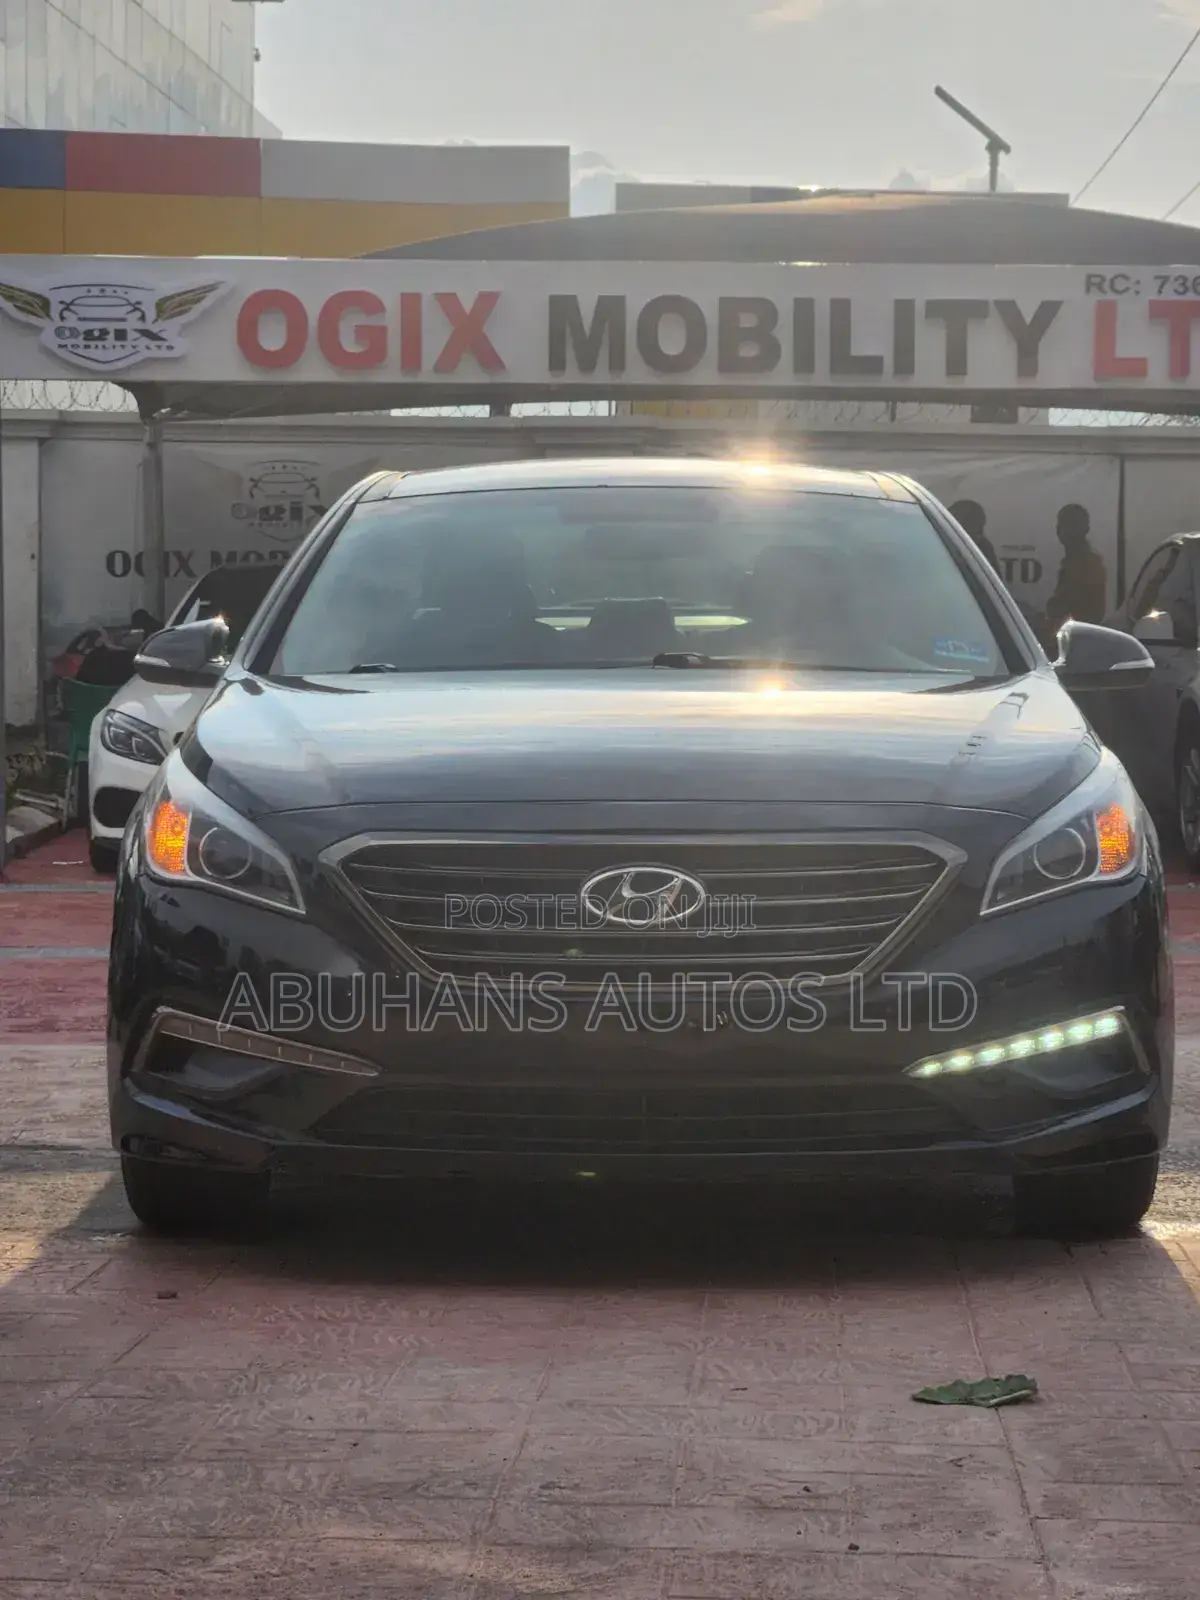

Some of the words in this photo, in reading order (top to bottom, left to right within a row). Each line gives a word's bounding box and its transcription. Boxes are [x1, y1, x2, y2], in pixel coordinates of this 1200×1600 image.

[1085, 273, 1141, 296] RC:
[236, 288, 506, 374] OGIX
[547, 294, 1063, 377] MOBILITY
